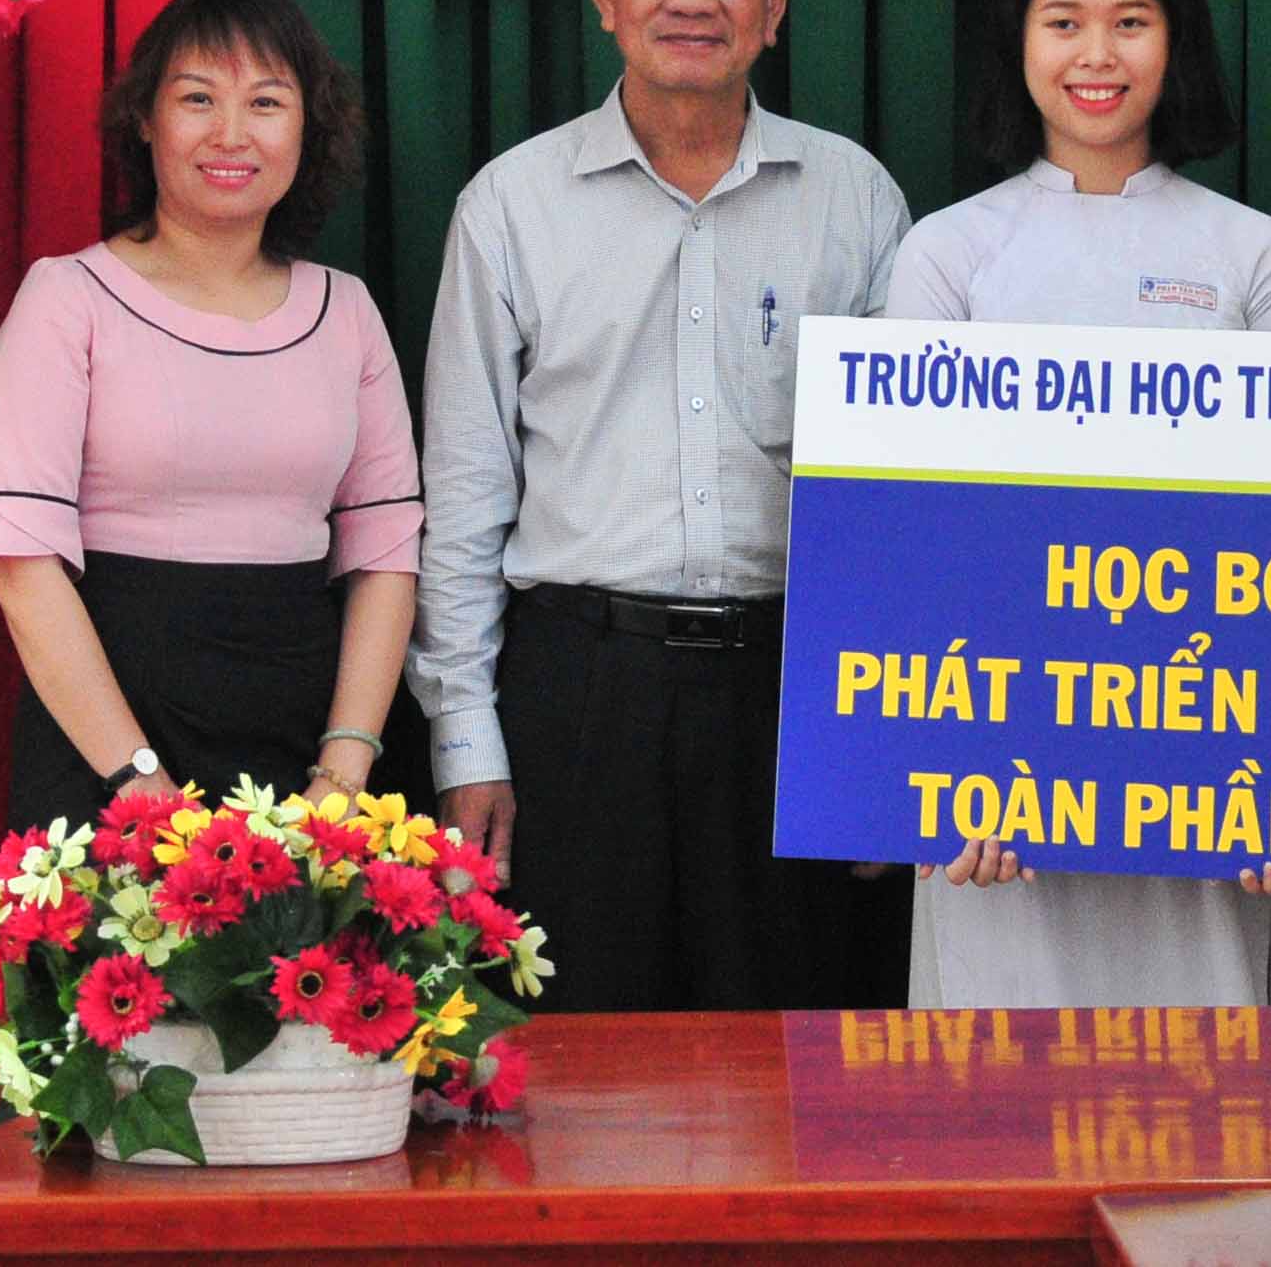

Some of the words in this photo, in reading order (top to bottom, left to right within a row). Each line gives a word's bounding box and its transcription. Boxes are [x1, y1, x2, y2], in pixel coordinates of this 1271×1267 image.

[840, 340, 1019, 410] TRƯỜNG
[1036, 359, 1111, 424] ĐẠI
[1131, 362, 1221, 428] HỌC
[1047, 545, 1189, 624] HỌC
[837, 639, 1020, 722] PHÁT
[1045, 632, 1256, 733] TRIỂN
[909, 759, 1097, 846] TOÀN
